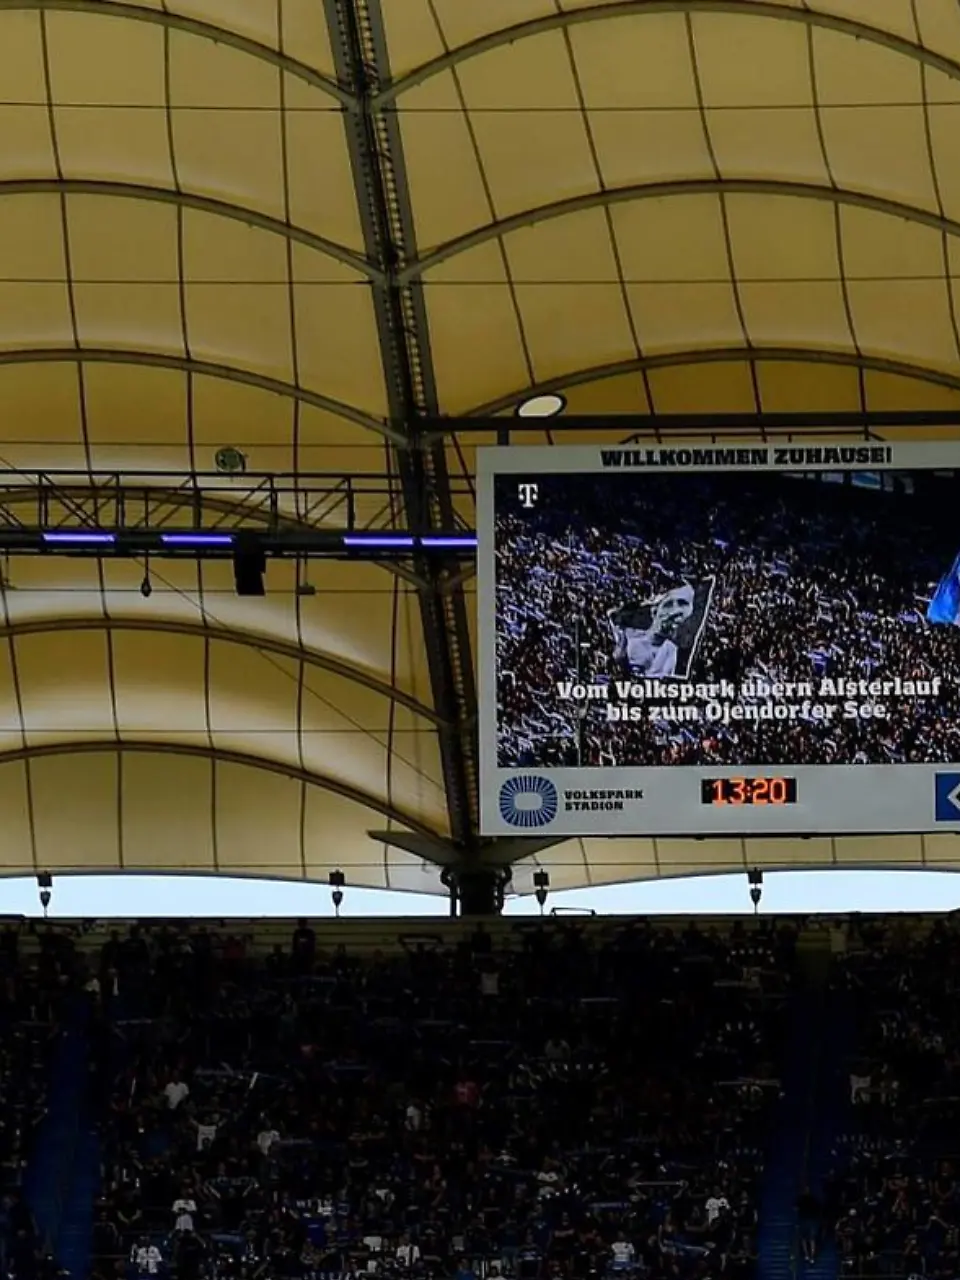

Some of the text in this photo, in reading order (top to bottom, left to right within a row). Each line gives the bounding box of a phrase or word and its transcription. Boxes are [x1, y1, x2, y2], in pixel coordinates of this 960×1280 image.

[602, 447, 893, 467] WILLKOMMEN ZUHAUSE!
[518, 483, 538, 508] T
[556, 681, 608, 699] Vom
[615, 679, 735, 702] Volkspark
[818, 677, 941, 696] Alsterlauf
[606, 702, 642, 721] bis
[648, 703, 700, 720] zum
[564, 789, 644, 799] VOLKSPARK
[711, 777, 788, 808] 13:20
[564, 801, 623, 811] STADION
